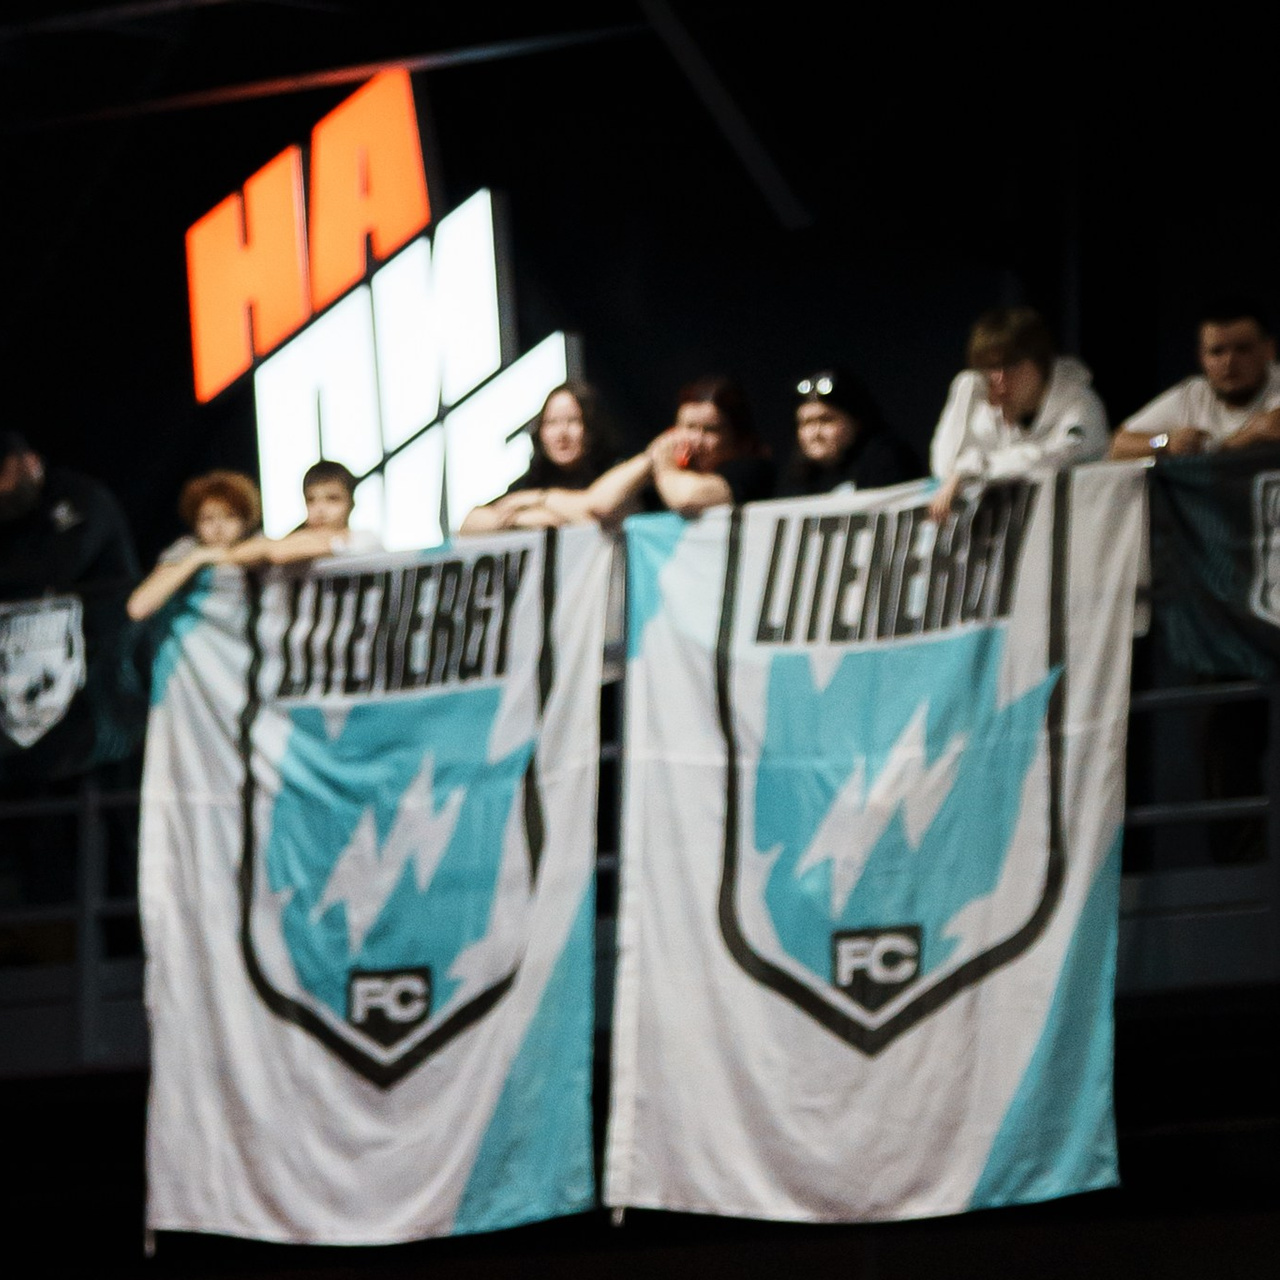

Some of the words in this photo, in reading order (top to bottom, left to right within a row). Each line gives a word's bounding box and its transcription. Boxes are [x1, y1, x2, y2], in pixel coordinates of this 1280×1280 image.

[185, 65, 431, 403] НА
[276, 548, 530, 695] LITENERGY
[755, 481, 1042, 642] LITENERGY
[352, 976, 427, 1023] FC
[836, 933, 919, 987] FC
